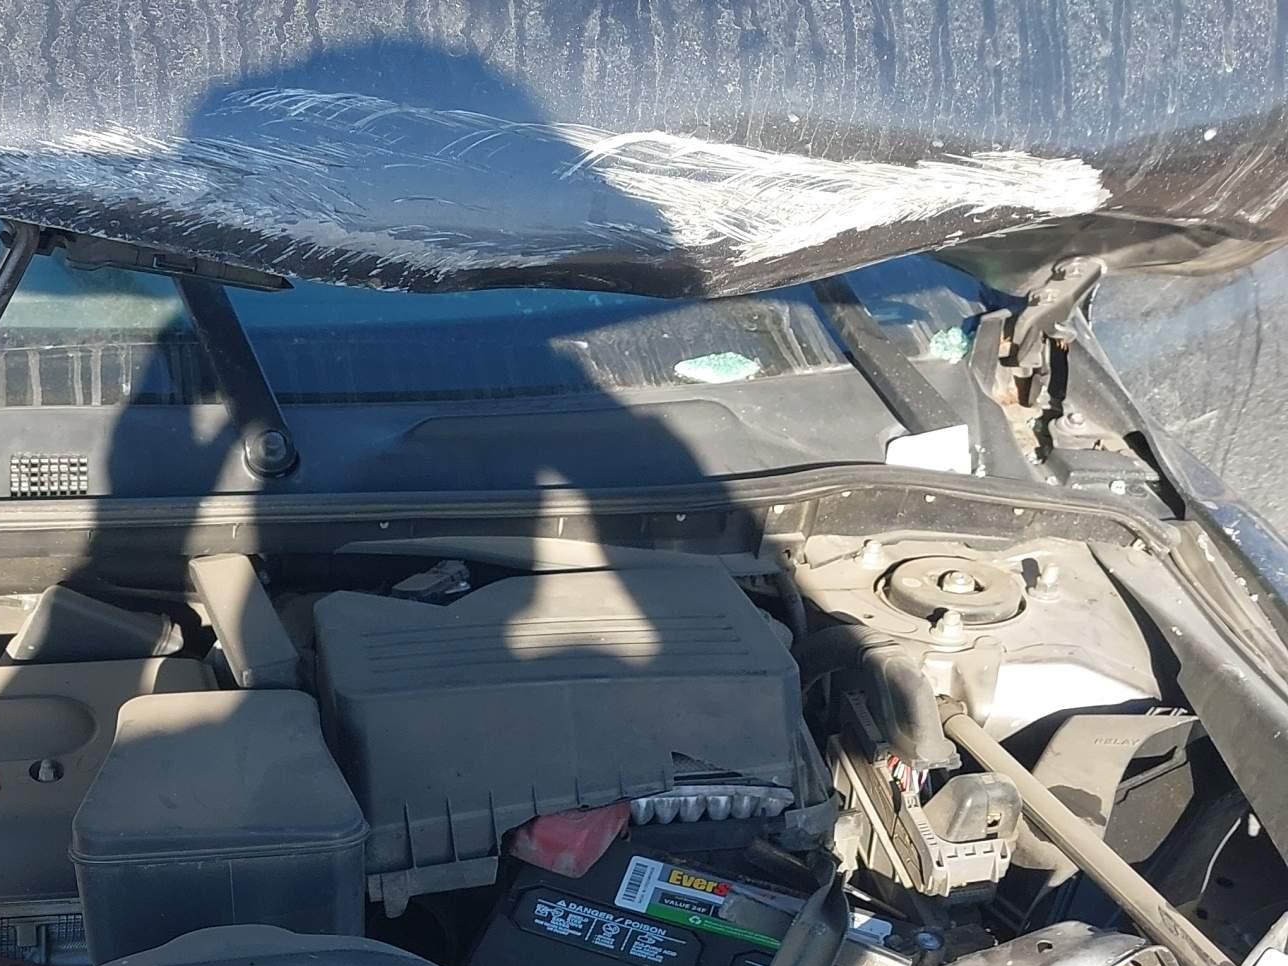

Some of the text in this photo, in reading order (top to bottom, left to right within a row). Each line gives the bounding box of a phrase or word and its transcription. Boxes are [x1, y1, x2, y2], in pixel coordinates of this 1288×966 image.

[663, 898, 690, 910] VALUE
[568, 903, 615, 921] DANGER
[625, 919, 668, 936] POISON
